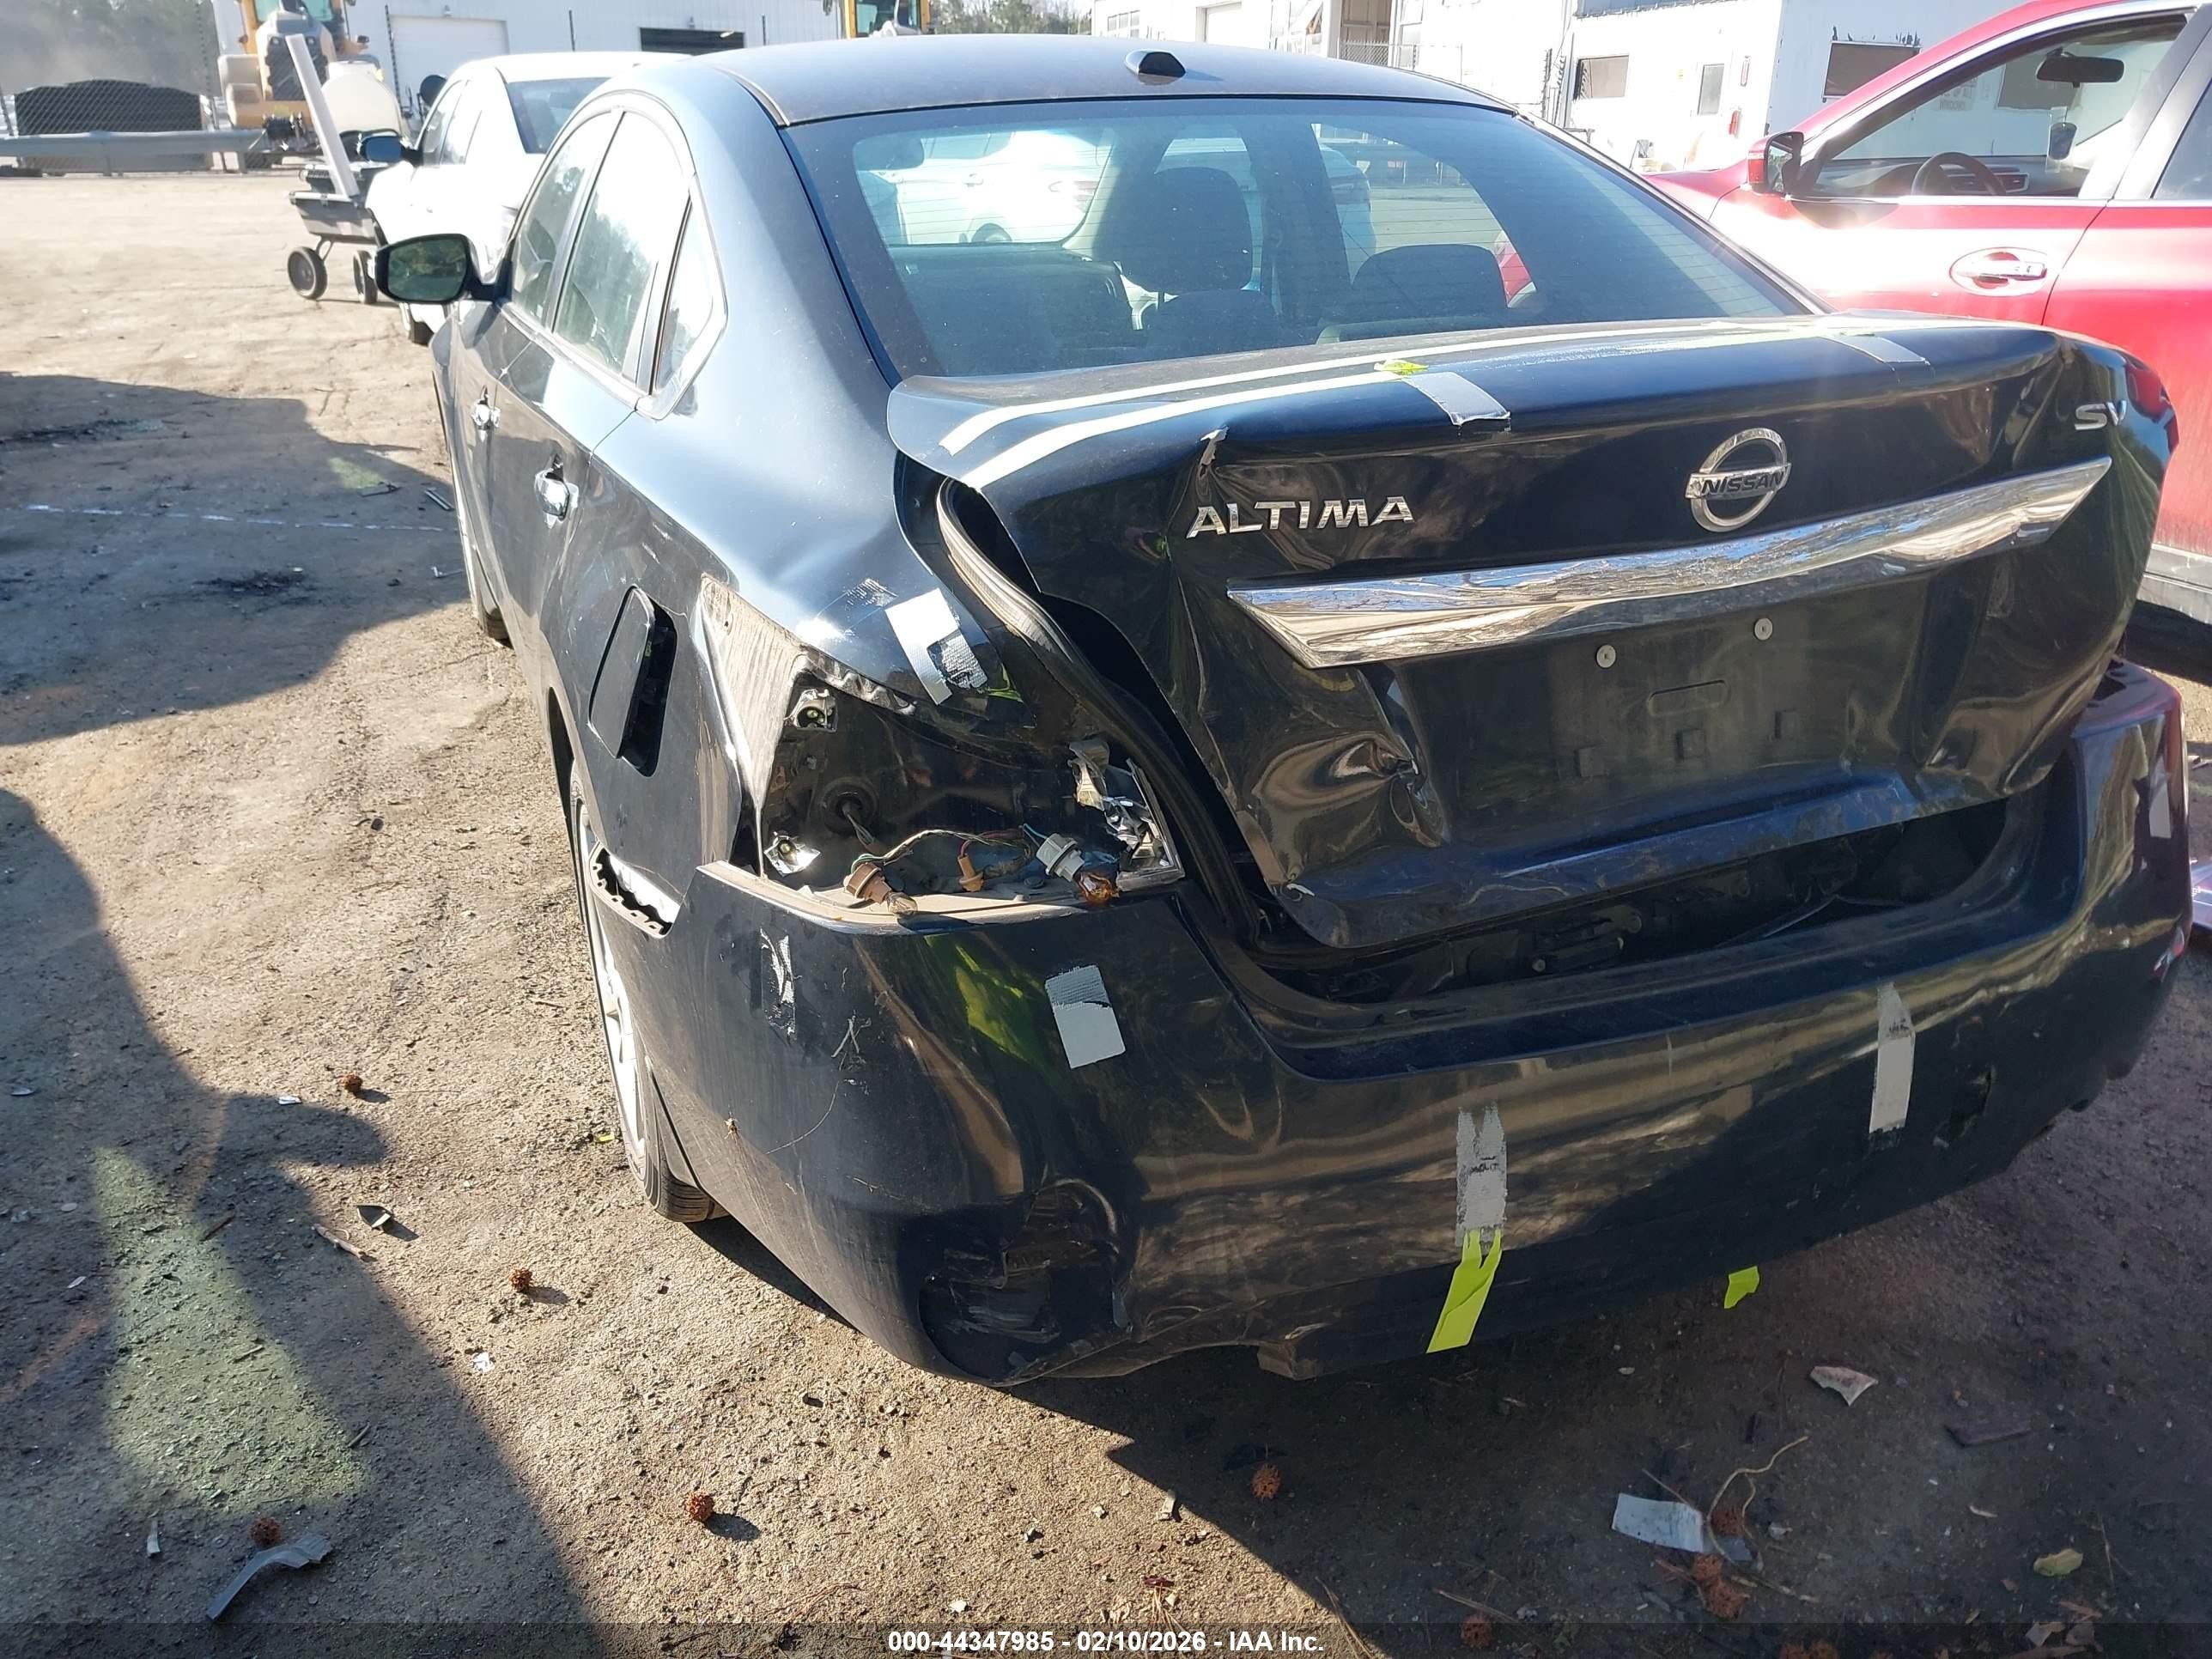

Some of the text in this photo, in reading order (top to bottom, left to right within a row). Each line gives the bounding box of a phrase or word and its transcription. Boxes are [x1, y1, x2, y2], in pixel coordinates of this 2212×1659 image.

[2075, 399, 2127, 430] SV
[1701, 470, 1785, 495] NISSAN
[1186, 496, 1415, 539] ALTIMA
